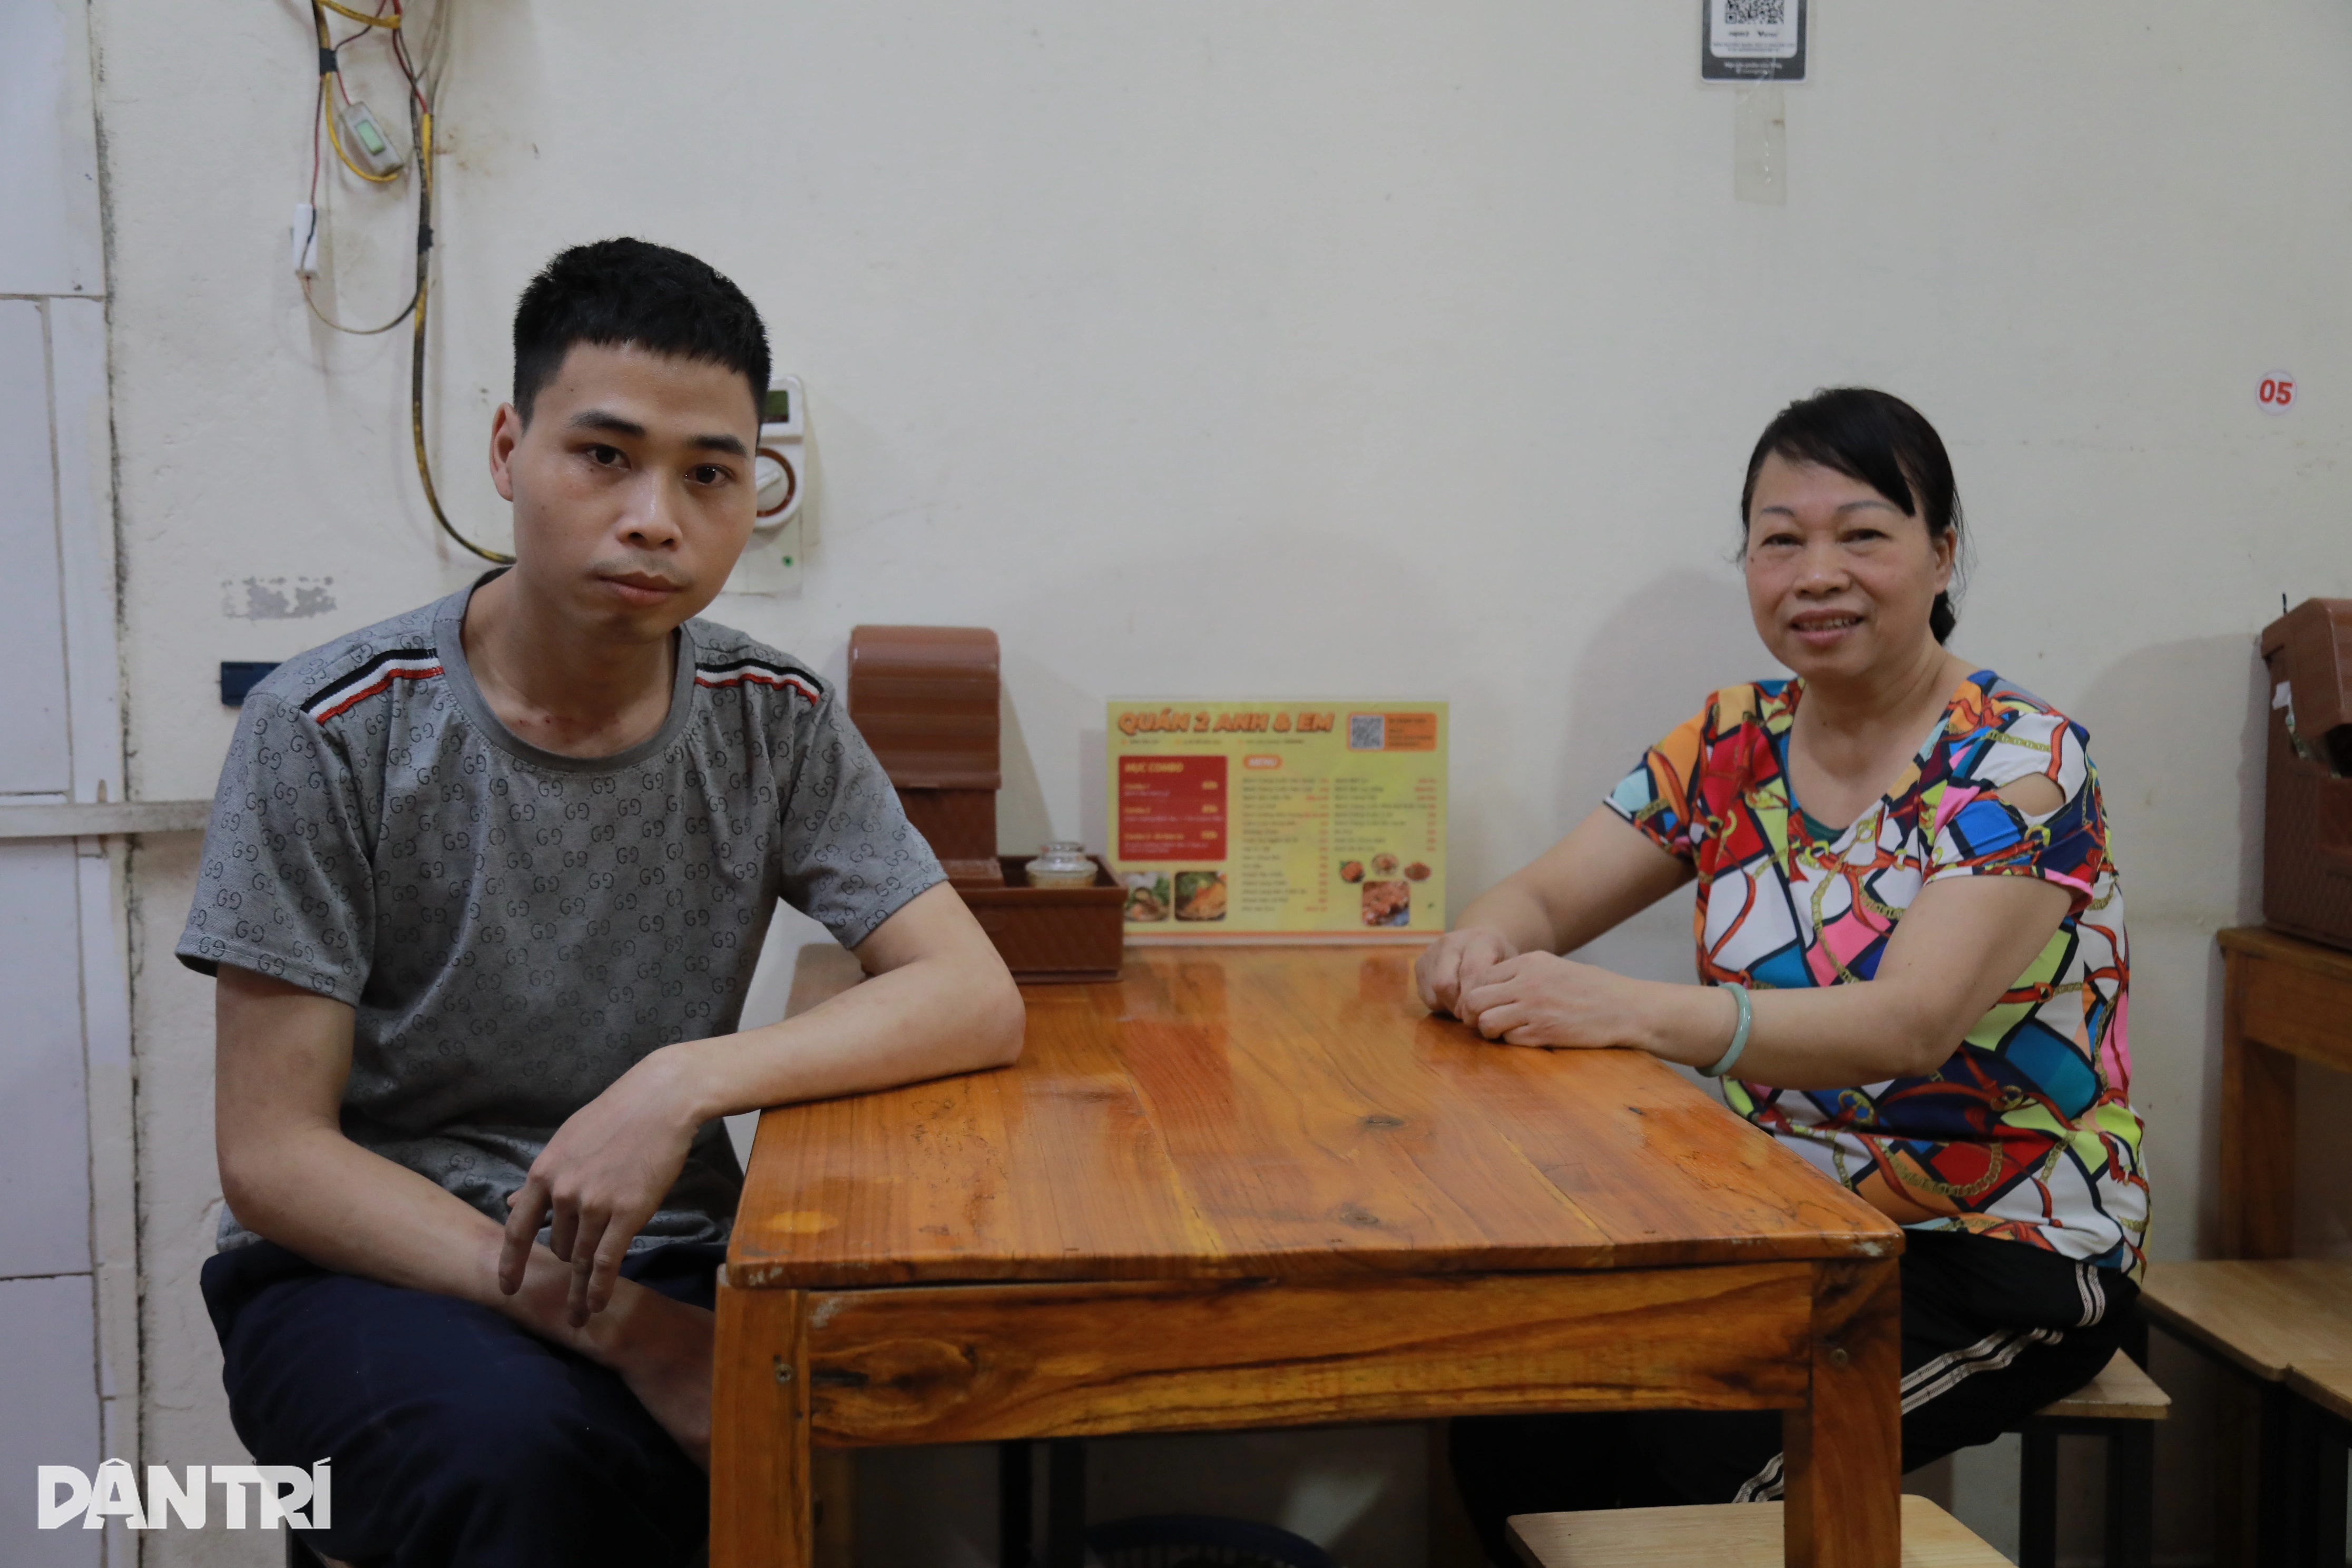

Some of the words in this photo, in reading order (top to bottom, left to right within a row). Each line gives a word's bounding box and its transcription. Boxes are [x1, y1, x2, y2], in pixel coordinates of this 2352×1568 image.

[2259, 379, 2294, 405] 05
[1119, 708, 1190, 736] QUÁN
[1194, 711, 1210, 732] 2
[1213, 712, 1269, 732] ANH
[1272, 712, 1291, 732] &
[1296, 712, 1335, 733] EM
[1248, 757, 1278, 767] MENU
